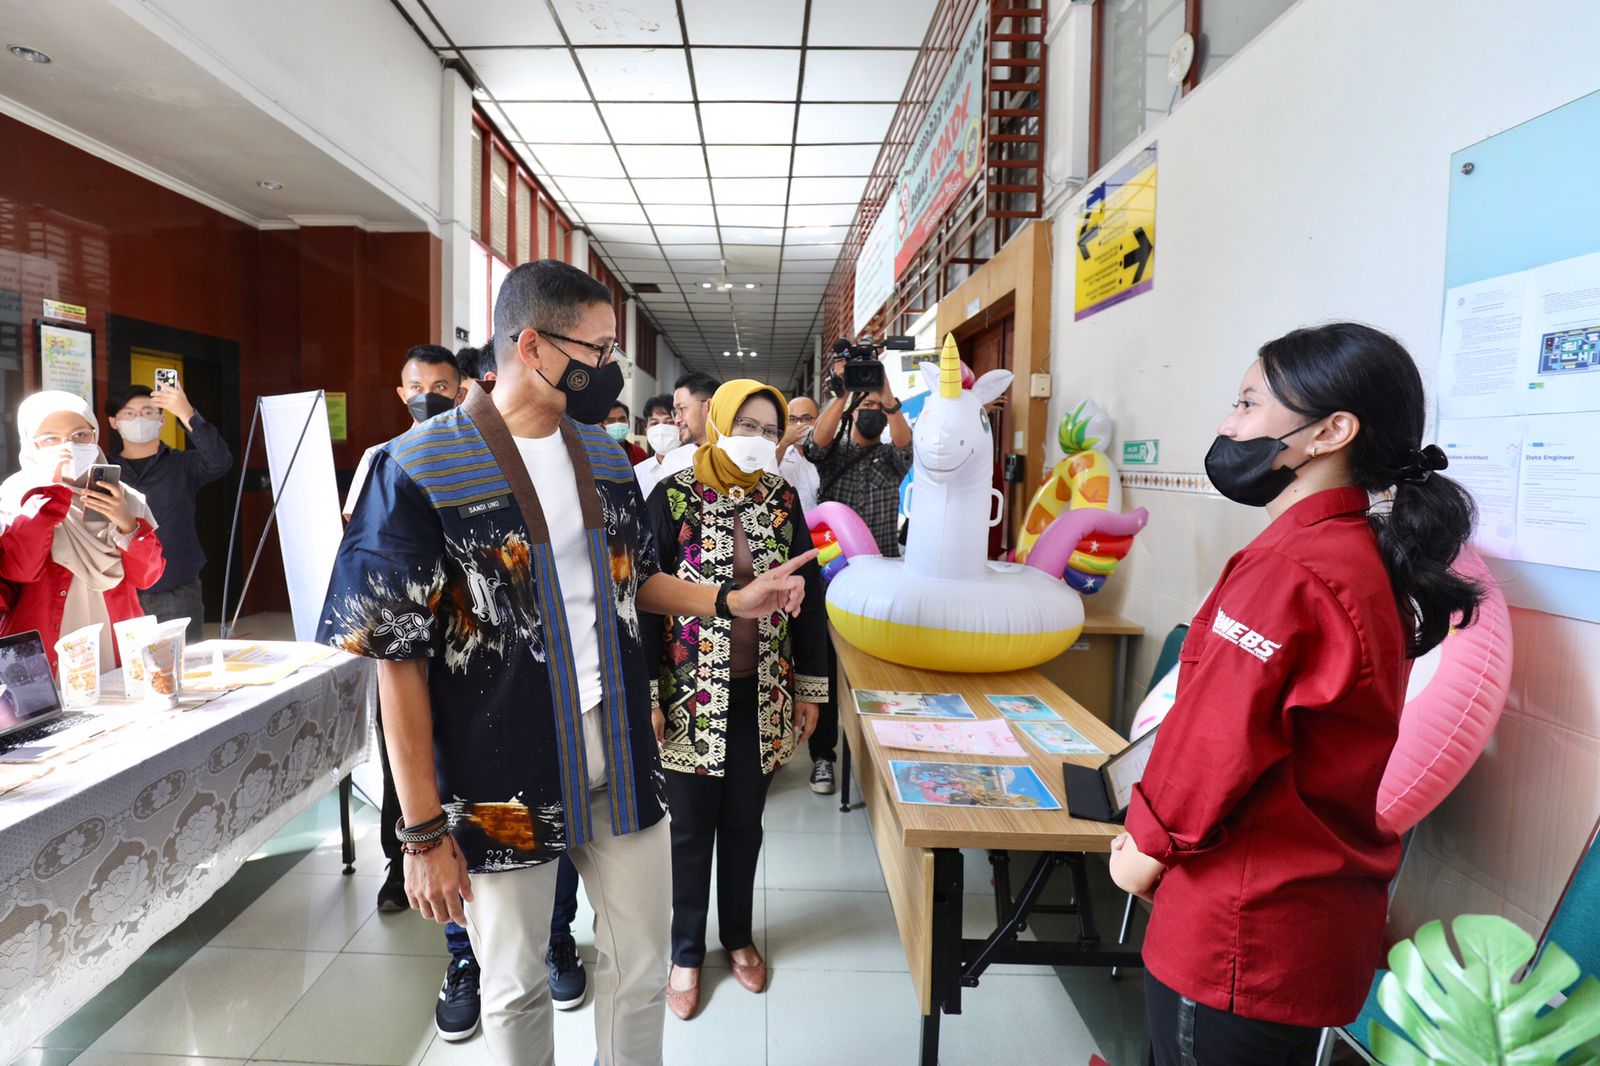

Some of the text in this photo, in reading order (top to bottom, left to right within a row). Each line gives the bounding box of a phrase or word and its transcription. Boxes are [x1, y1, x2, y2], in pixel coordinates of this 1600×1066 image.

[1544, 454, 1575, 462] Engineer
[468, 500, 500, 514] SANDI UNO
